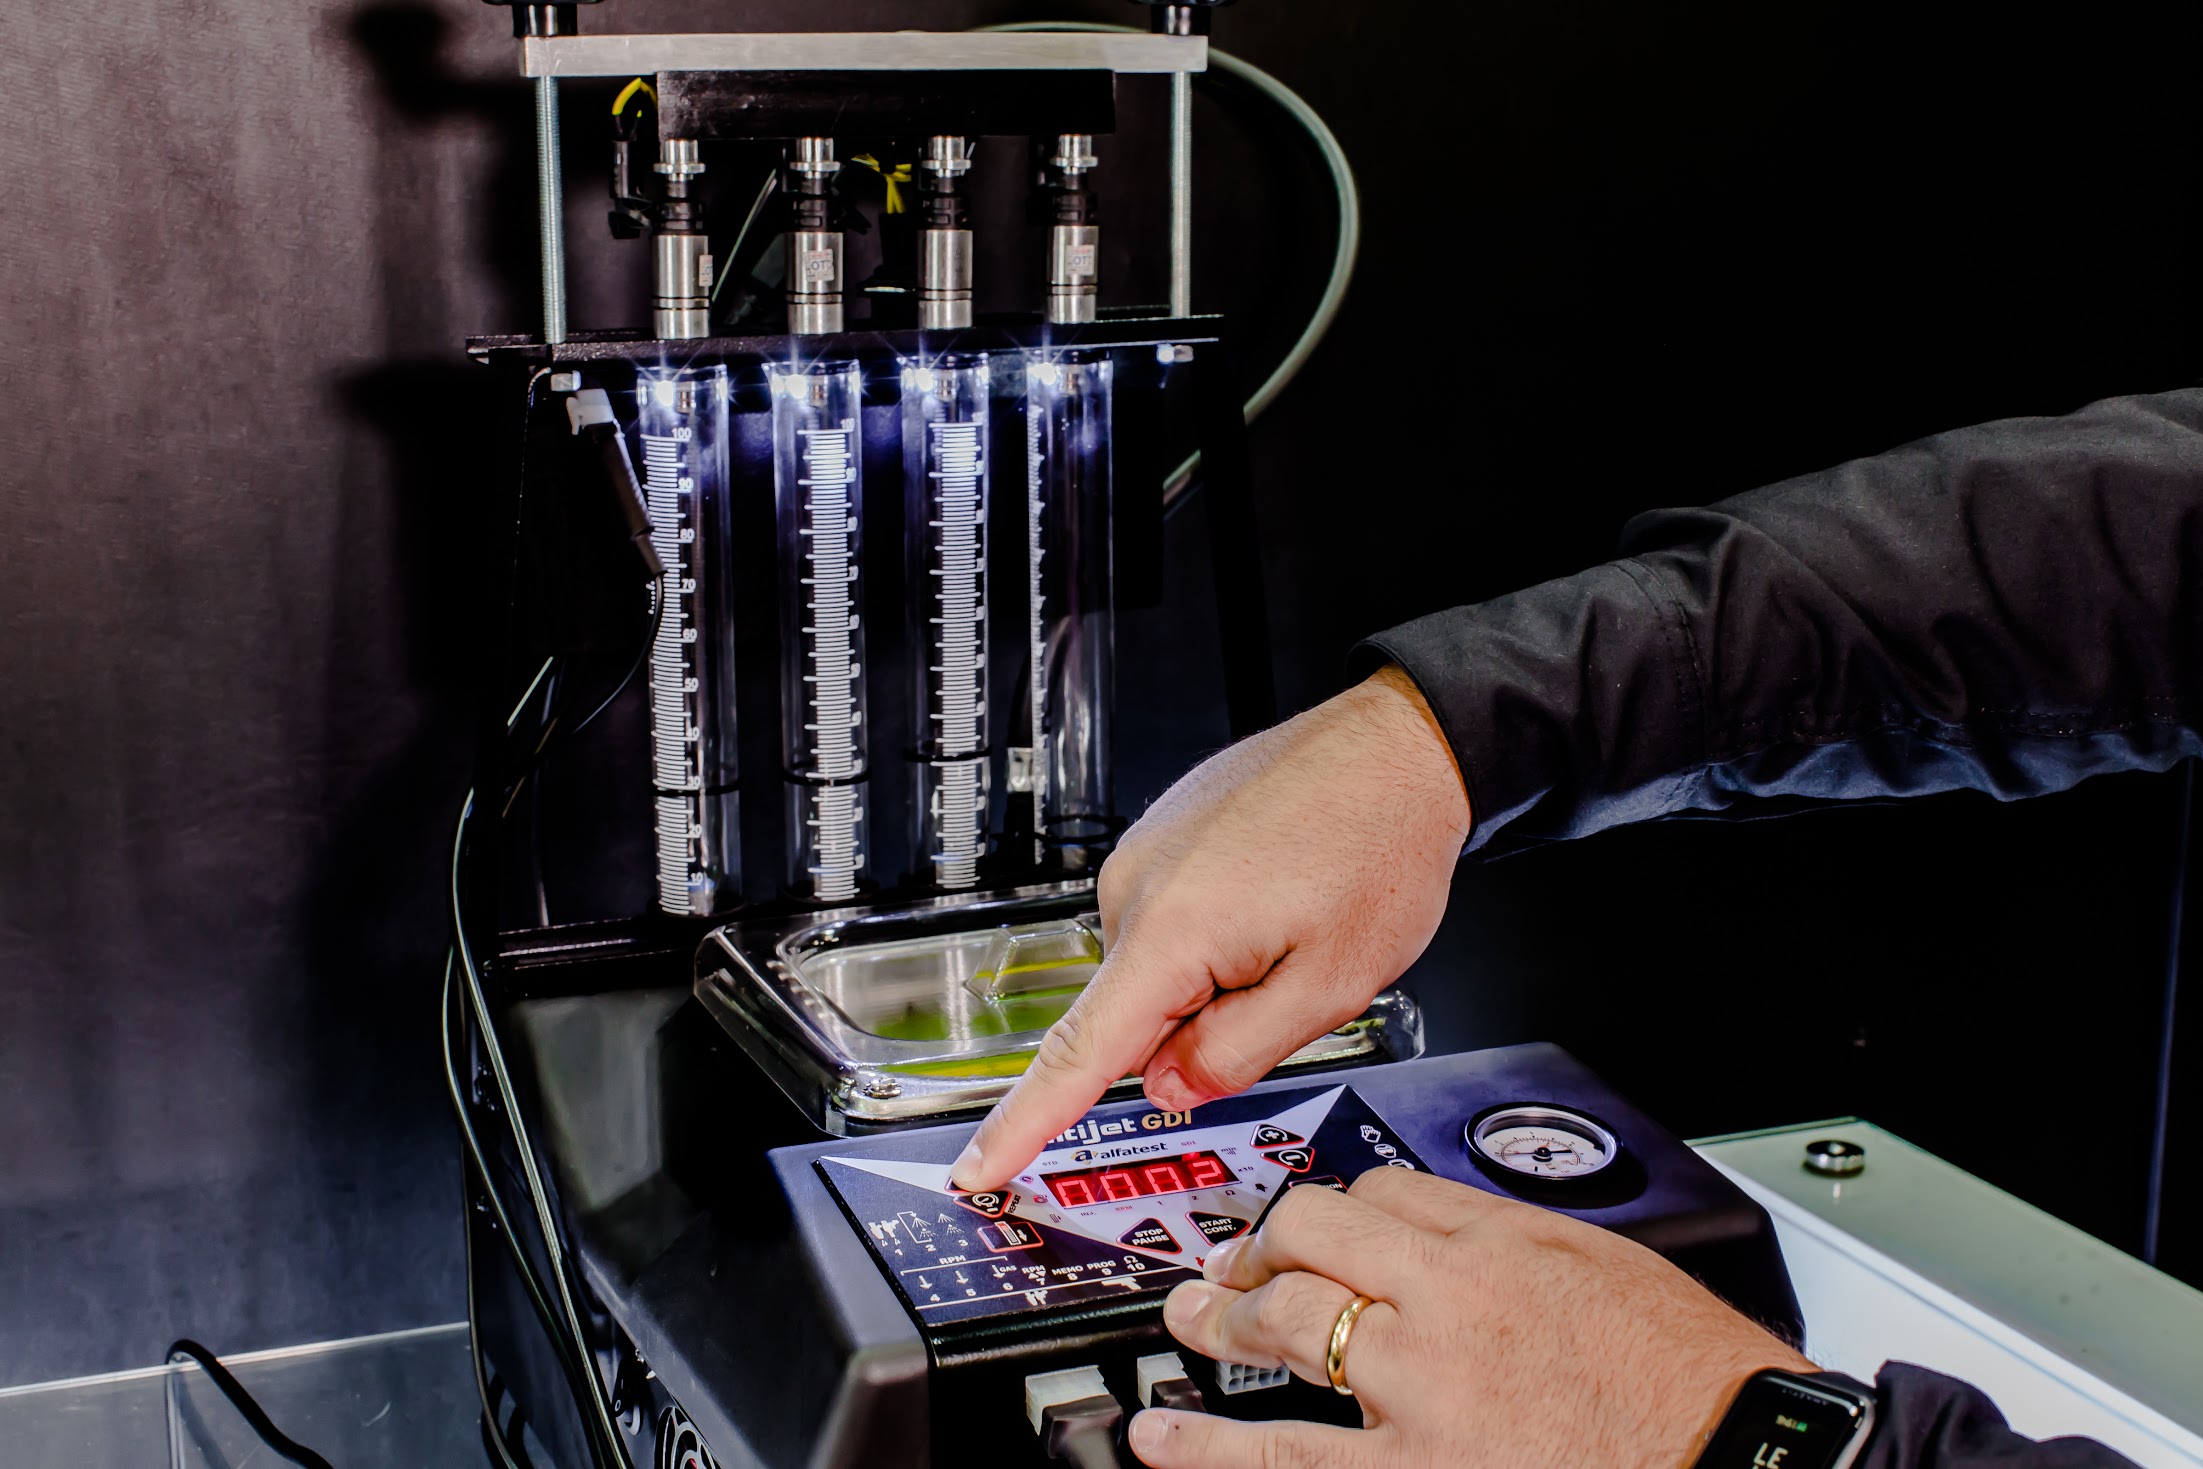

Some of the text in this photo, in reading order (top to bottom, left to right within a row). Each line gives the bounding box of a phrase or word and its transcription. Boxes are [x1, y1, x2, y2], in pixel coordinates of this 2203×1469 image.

[672, 427, 692, 439] 100
[678, 478, 693, 490] 90
[682, 578, 697, 590] 70
[687, 776, 700, 788] 30
[689, 824, 702, 837] 20
[691, 872, 703, 884] 10
[1047, 1109, 1192, 1144] tijet GDI
[1100, 1142, 1168, 1159] alfatest
[1198, 1218, 1232, 1229] START
[1203, 1223, 1237, 1235] CONT.
[1134, 1228, 1164, 1238] STOP
[958, 1239, 969, 1247] 3
[1131, 1234, 1170, 1246] PAUSE
[925, 1244, 936, 1252] 2
[938, 1254, 967, 1265] RPM
[1086, 1259, 1117, 1271] PROG
[999, 1264, 1017, 1273] GAS
[1021, 1264, 1045, 1275] RPM
[1051, 1264, 1084, 1276] MEMO
[1101, 1267, 1112, 1276] 9
[1127, 1262, 1146, 1273] 10
[1035, 1277, 1046, 1286] 7
[1067, 1272, 1078, 1282] 8
[1002, 1282, 1014, 1291] 6
[930, 1293, 941, 1303] 4
[965, 1288, 977, 1297] 5
